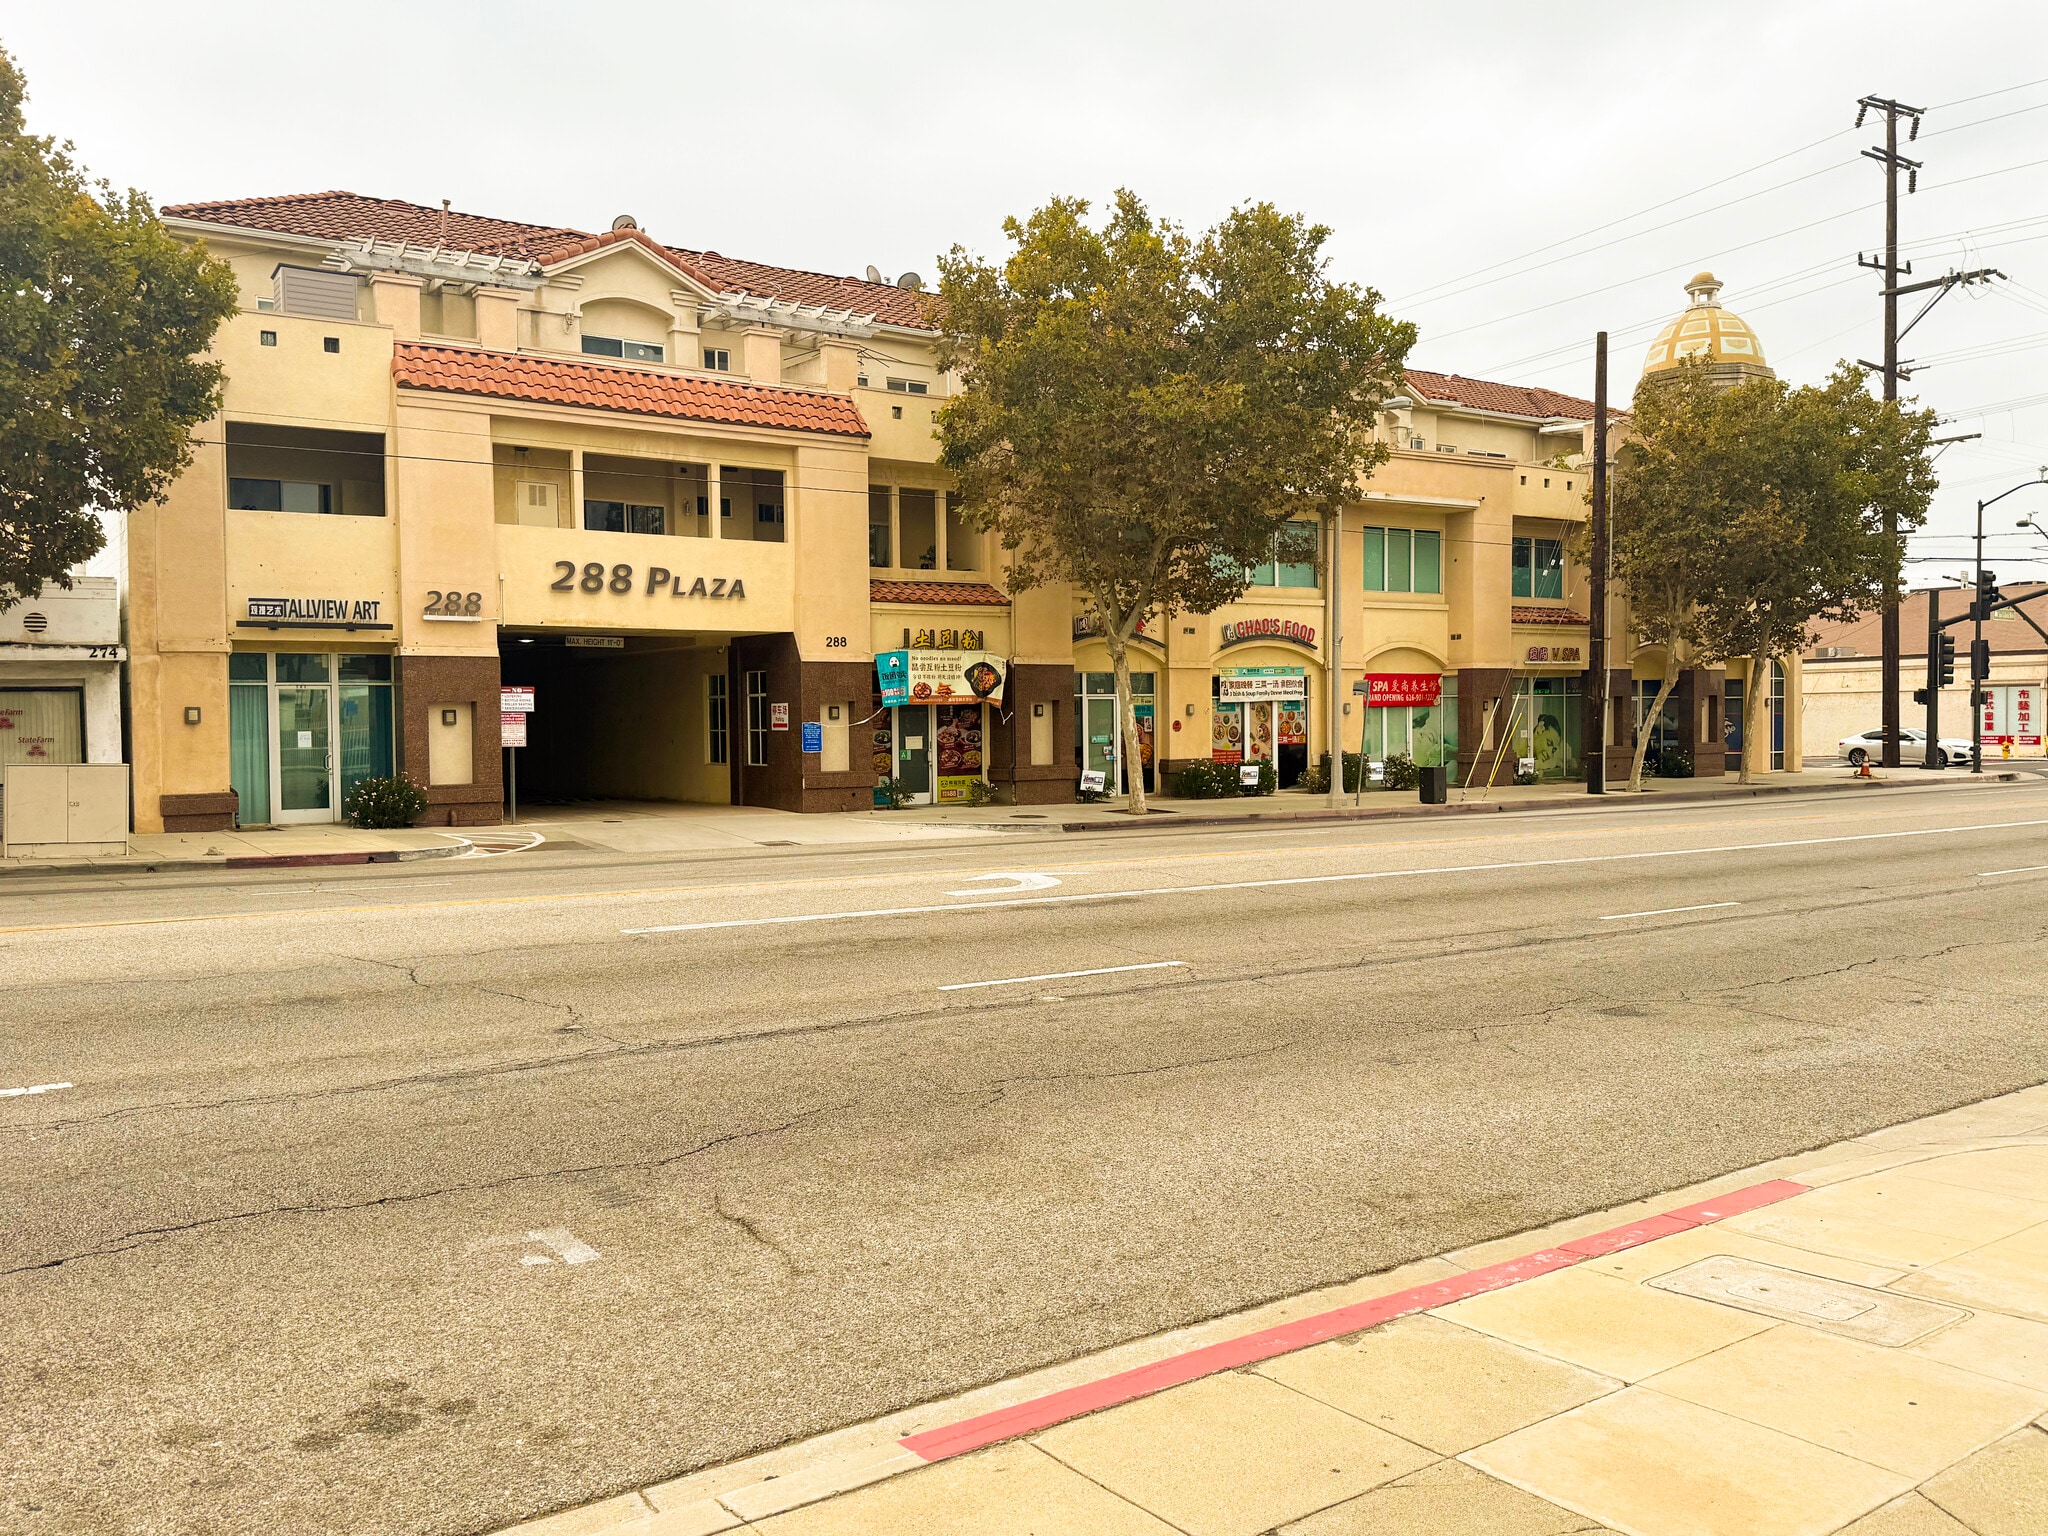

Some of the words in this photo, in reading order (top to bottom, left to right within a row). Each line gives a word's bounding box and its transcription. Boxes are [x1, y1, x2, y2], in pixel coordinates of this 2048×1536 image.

[551, 560, 633, 594] 288
[646, 566, 746, 599] PLAZA
[262, 598, 348, 620] TALLVIEW
[353, 600, 380, 620] ART
[423, 590, 482, 614] 288
[1283, 619, 1316, 643] FOOD
[583, 638, 605, 647] HEIGHT
[826, 636, 847, 648] 288
[912, 629, 980, 650] 土豆粉
[89, 646, 118, 659] 274
[1562, 647, 1580, 661] SPA
[1372, 680, 1389, 692] SPA
[1382, 694, 1404, 702] OPENING
